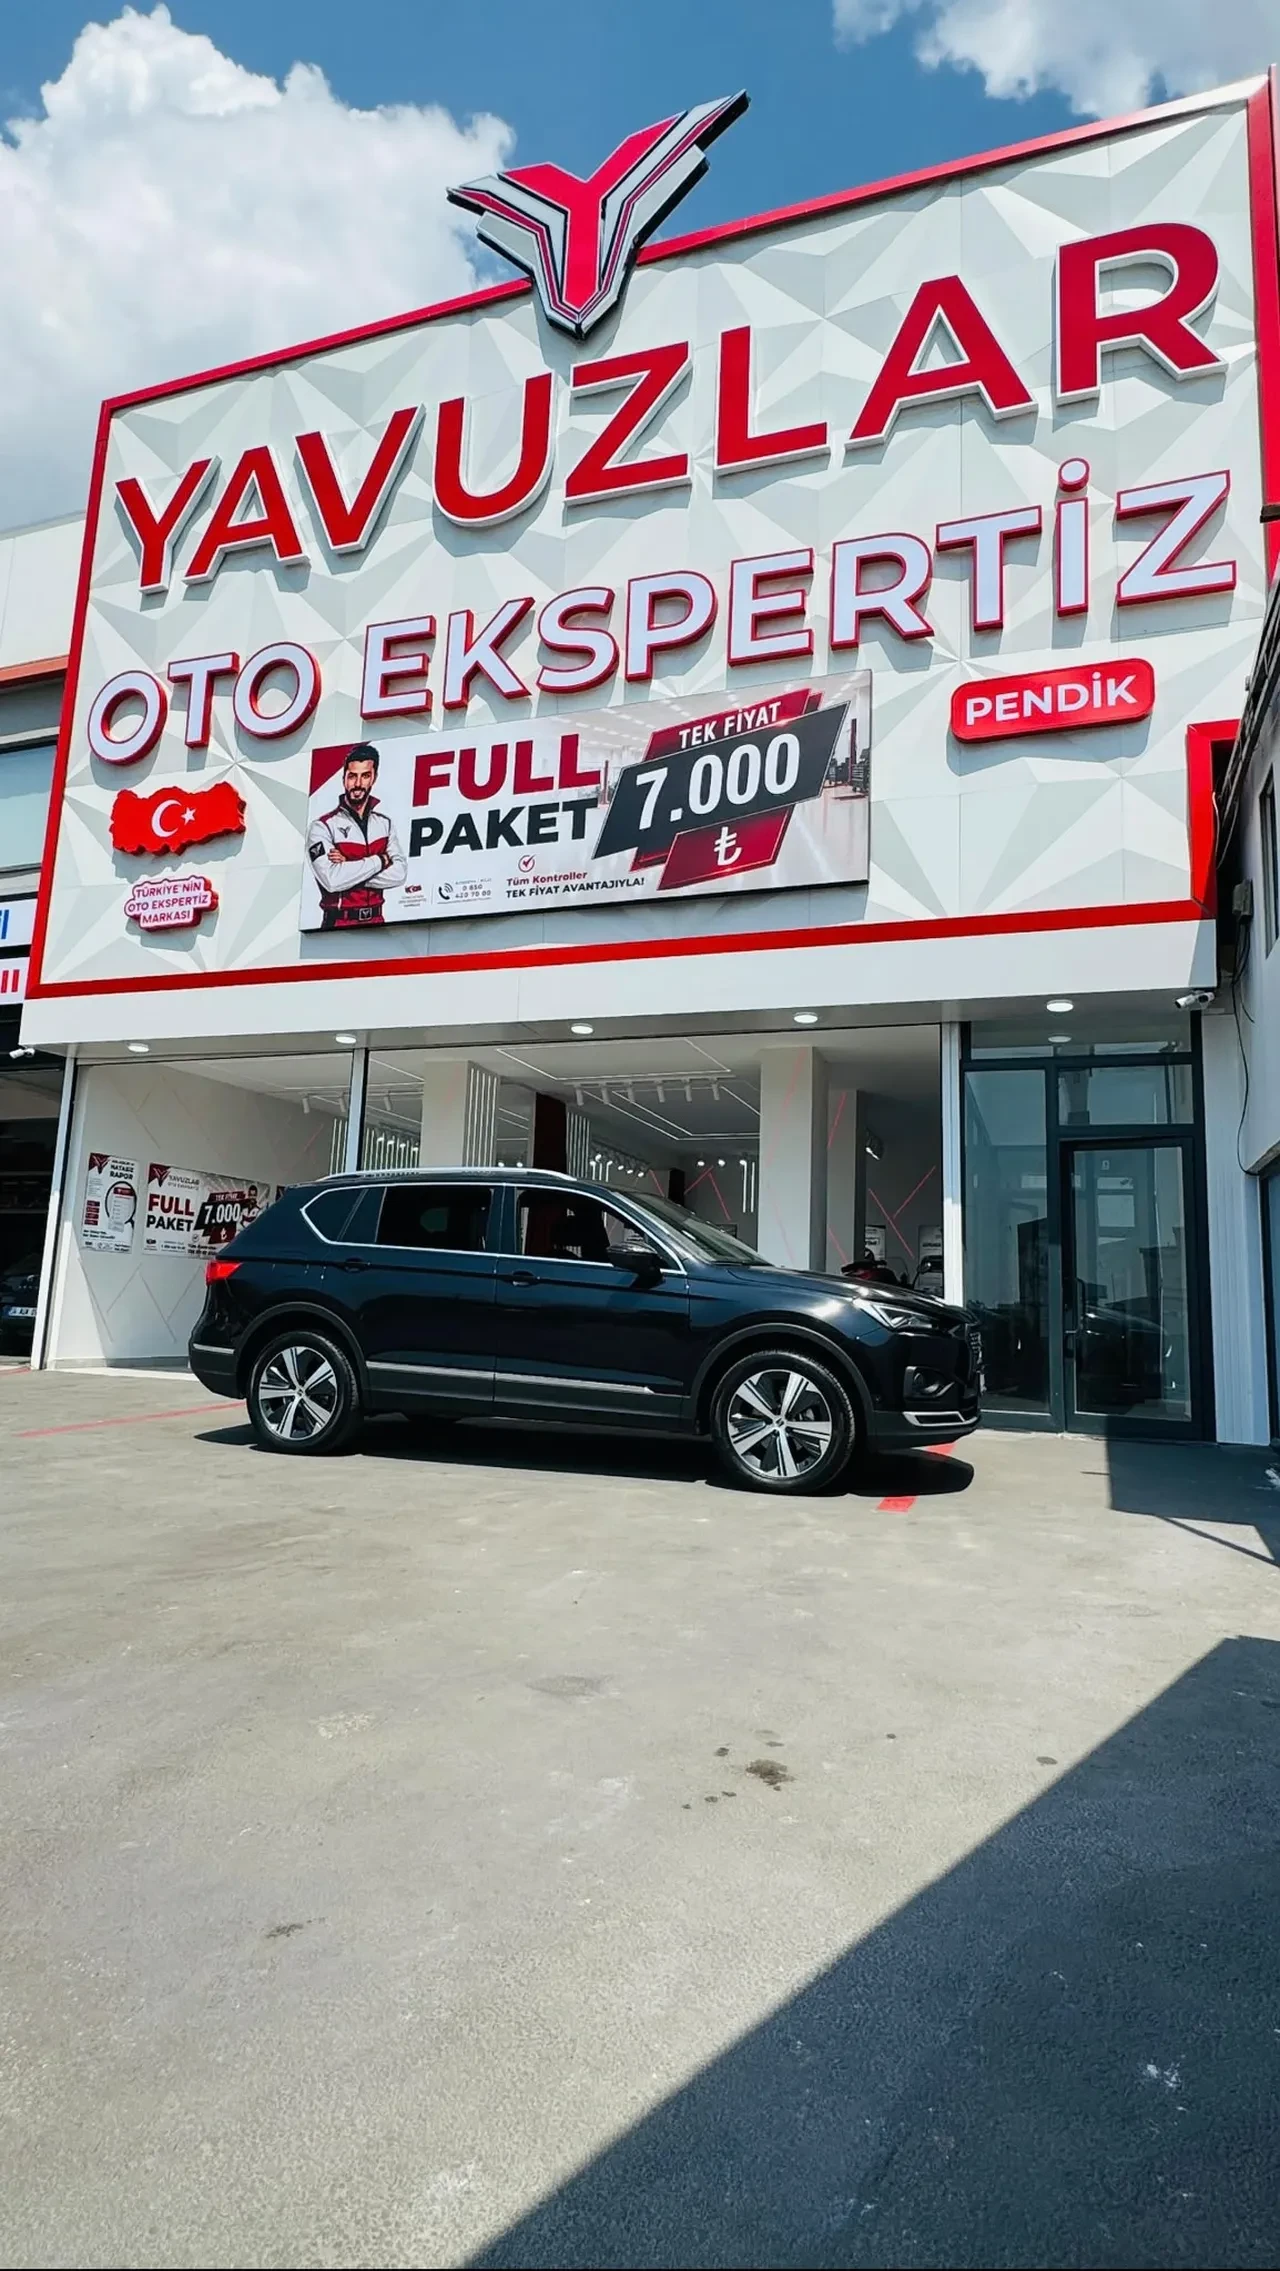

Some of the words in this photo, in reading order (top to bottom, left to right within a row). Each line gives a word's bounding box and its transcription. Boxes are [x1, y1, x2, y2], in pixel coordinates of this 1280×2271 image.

[115, 222, 1228, 594] YAVUZLAR
[88, 642, 321, 765] OTO
[360, 457, 1237, 719] EKSPERTİZ
[966, 671, 1138, 726] PENDİK
[679, 722, 716, 749] TEK
[722, 701, 780, 739] FİYAT
[413, 733, 602, 808] FULL
[635, 732, 801, 831] 7.000
[409, 798, 598, 858] PAKET
[506, 877, 530, 887] Tüm
[532, 871, 588, 885] Kontroller
[506, 888, 526, 899] TEK
[528, 886, 560, 897] FİYAT
[562, 877, 645, 894] AVANTAJIYLA!
[128, 901, 149, 912] OTO
[151, 893, 209, 910] EKSPERTİZ
[142, 910, 191, 923] MARKASI
[148, 1193, 194, 1216] FULL
[204, 1203, 241, 1224] 7.000
[146, 1214, 194, 1232] PAKET
